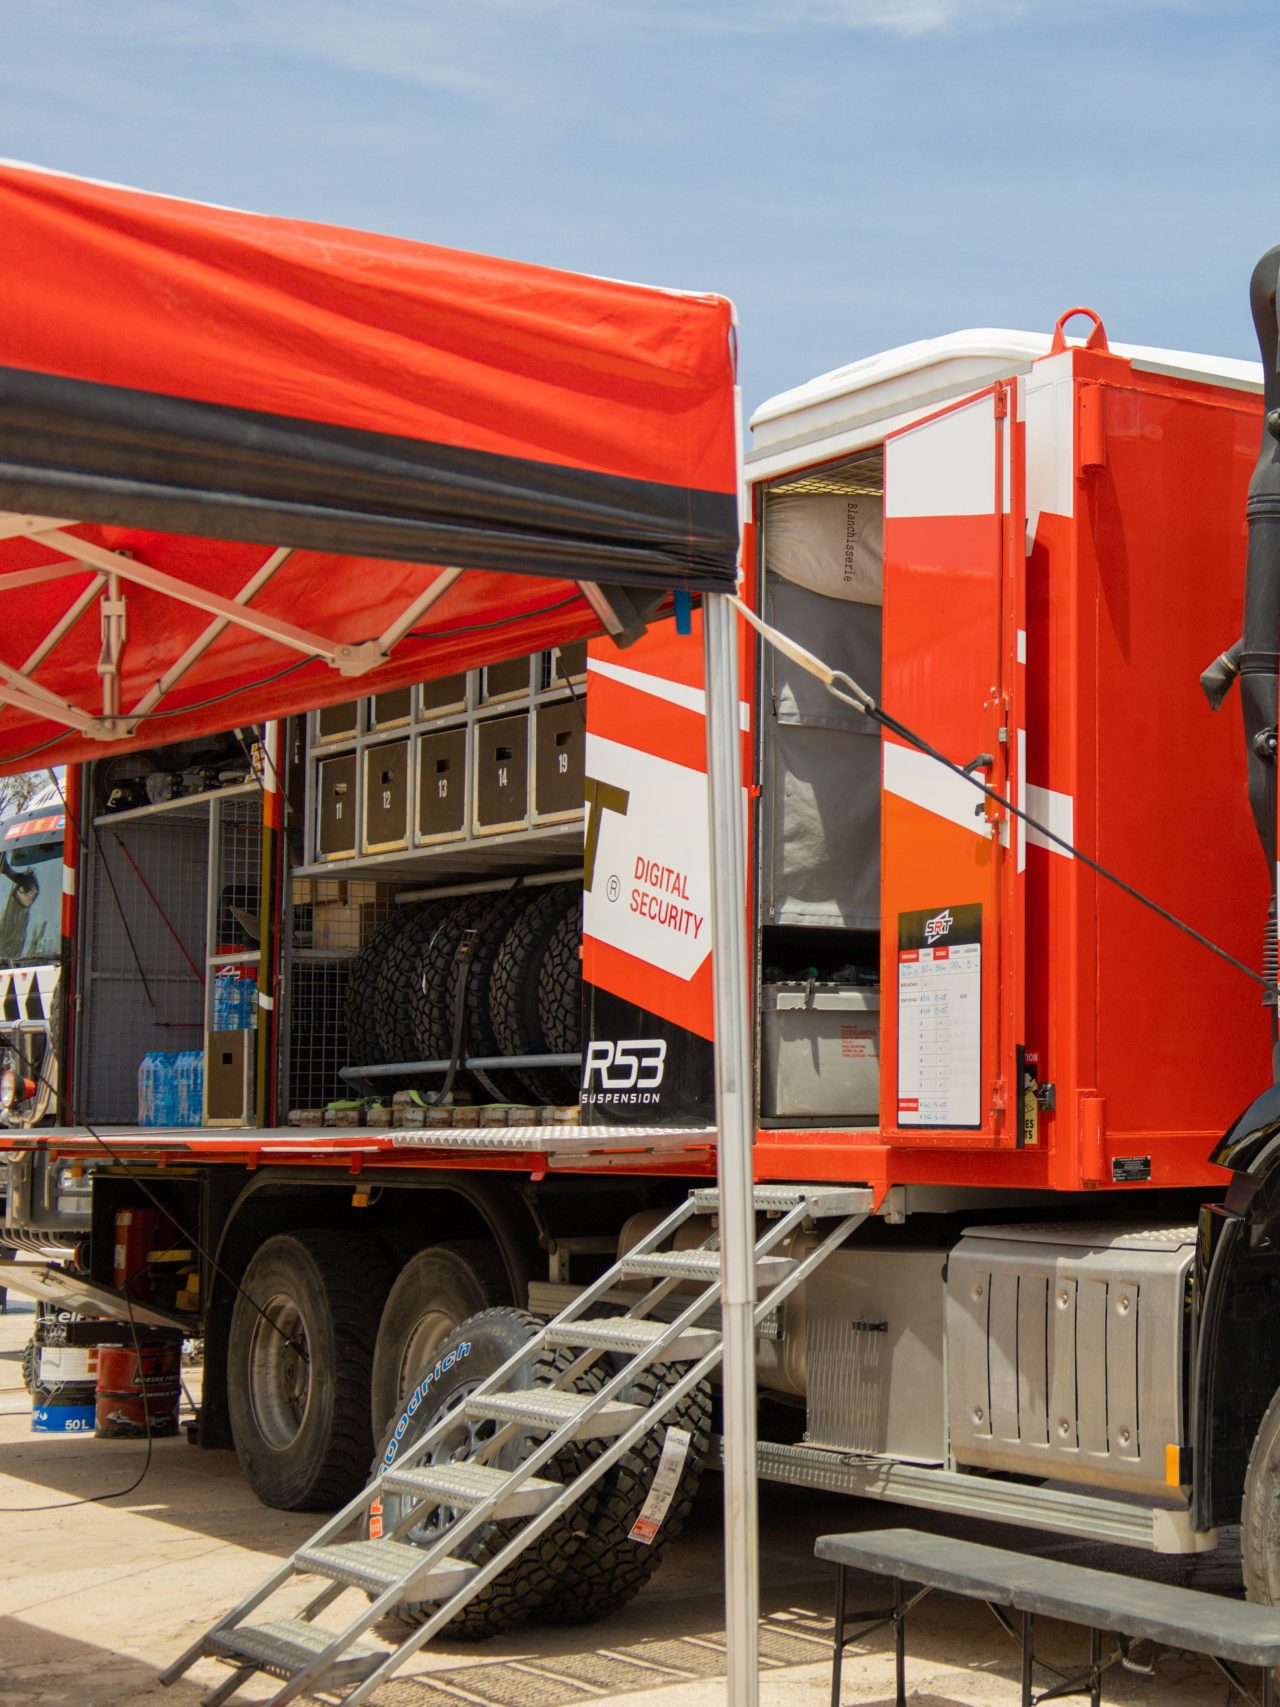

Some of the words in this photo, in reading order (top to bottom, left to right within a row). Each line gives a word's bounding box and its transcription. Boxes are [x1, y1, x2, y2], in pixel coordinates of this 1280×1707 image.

[843, 502, 859, 583] Blanchisserie
[558, 753, 568, 774] 19
[498, 767, 508, 787] 14
[438, 779, 448, 798] 13
[383, 790, 391, 809] 12
[336, 802, 343, 820] 11
[634, 855, 690, 901] DIGITAL
[629, 888, 704, 940] SECURITY
[925, 917, 953, 936] SRT
[583, 1038, 667, 1089] R53
[581, 1093, 660, 1104] SUSPENSION
[65, 1419, 81, 1430] 50
